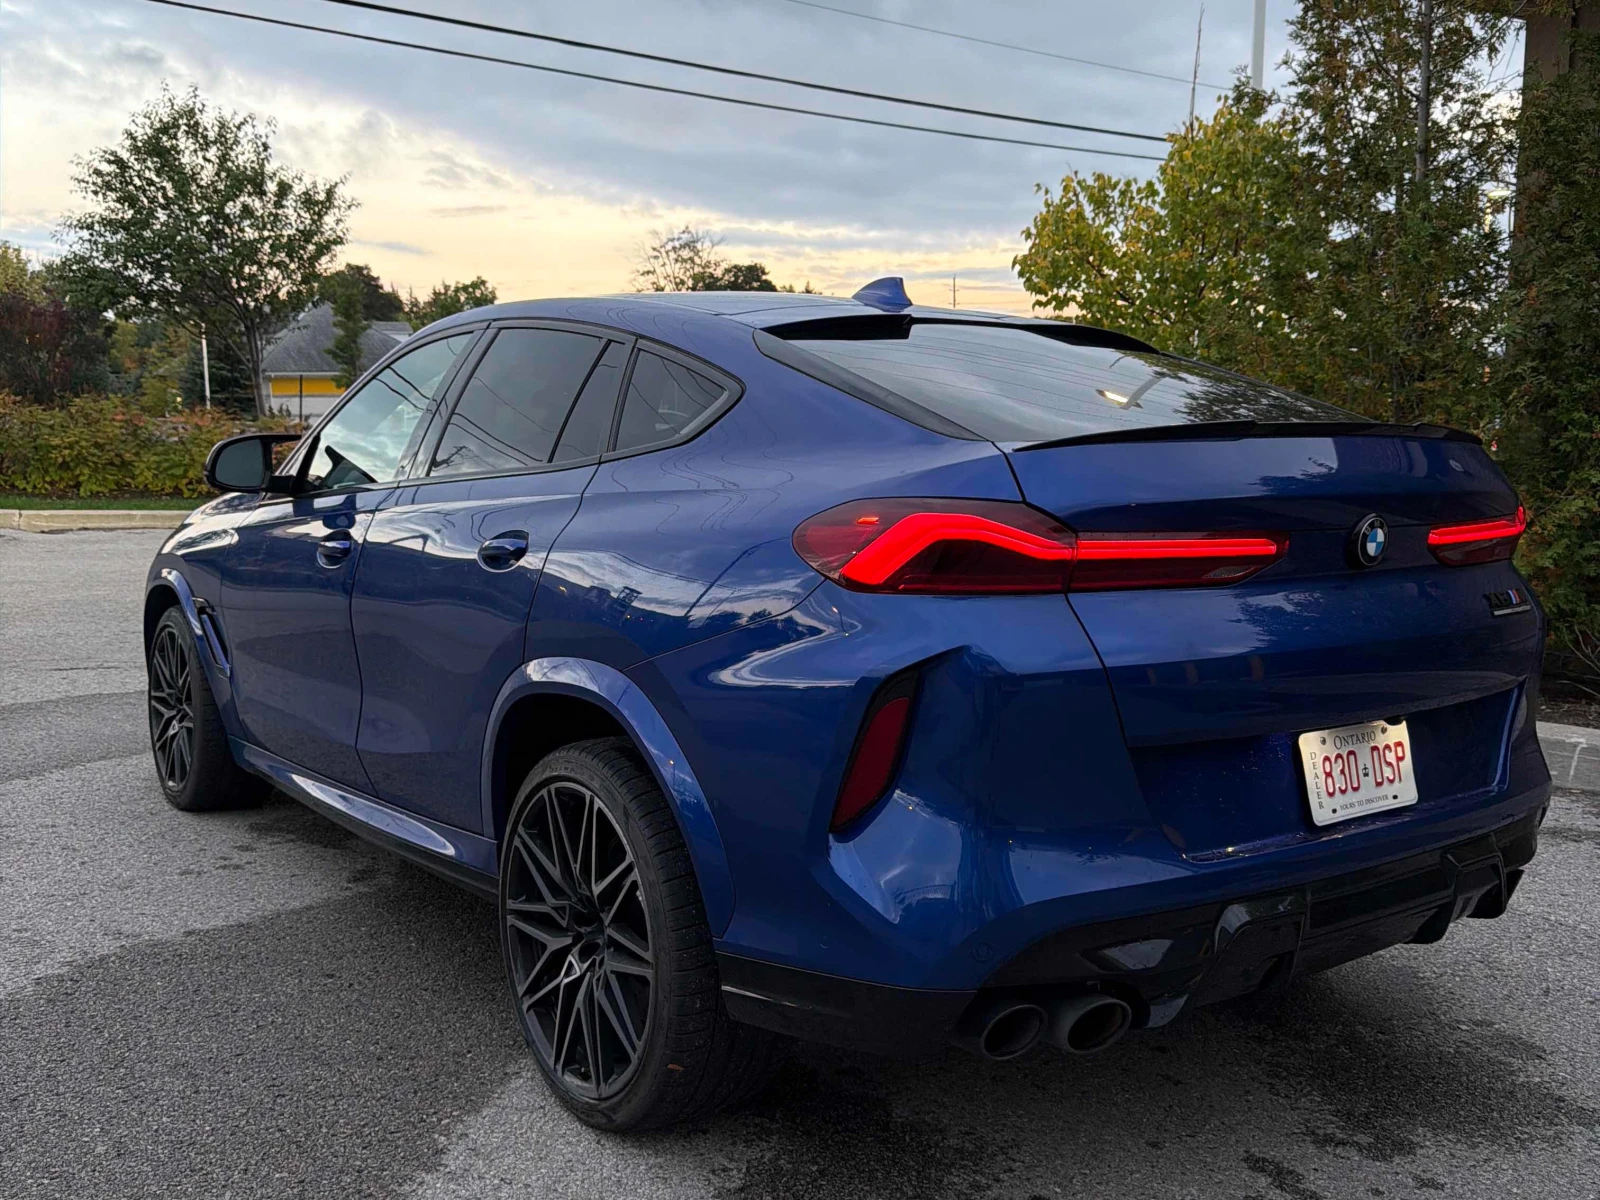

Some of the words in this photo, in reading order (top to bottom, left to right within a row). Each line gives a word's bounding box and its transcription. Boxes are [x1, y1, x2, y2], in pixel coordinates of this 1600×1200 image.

[1333, 730, 1376, 750] ONTARIO
[1310, 751, 1325, 810] DEALER
[1322, 749, 1361, 798] 830
[1370, 740, 1406, 787] DSP
[1340, 801, 1356, 811] YOURS
[1356, 799, 1365, 808] TO
[1365, 794, 1389, 806] DISCOVER
